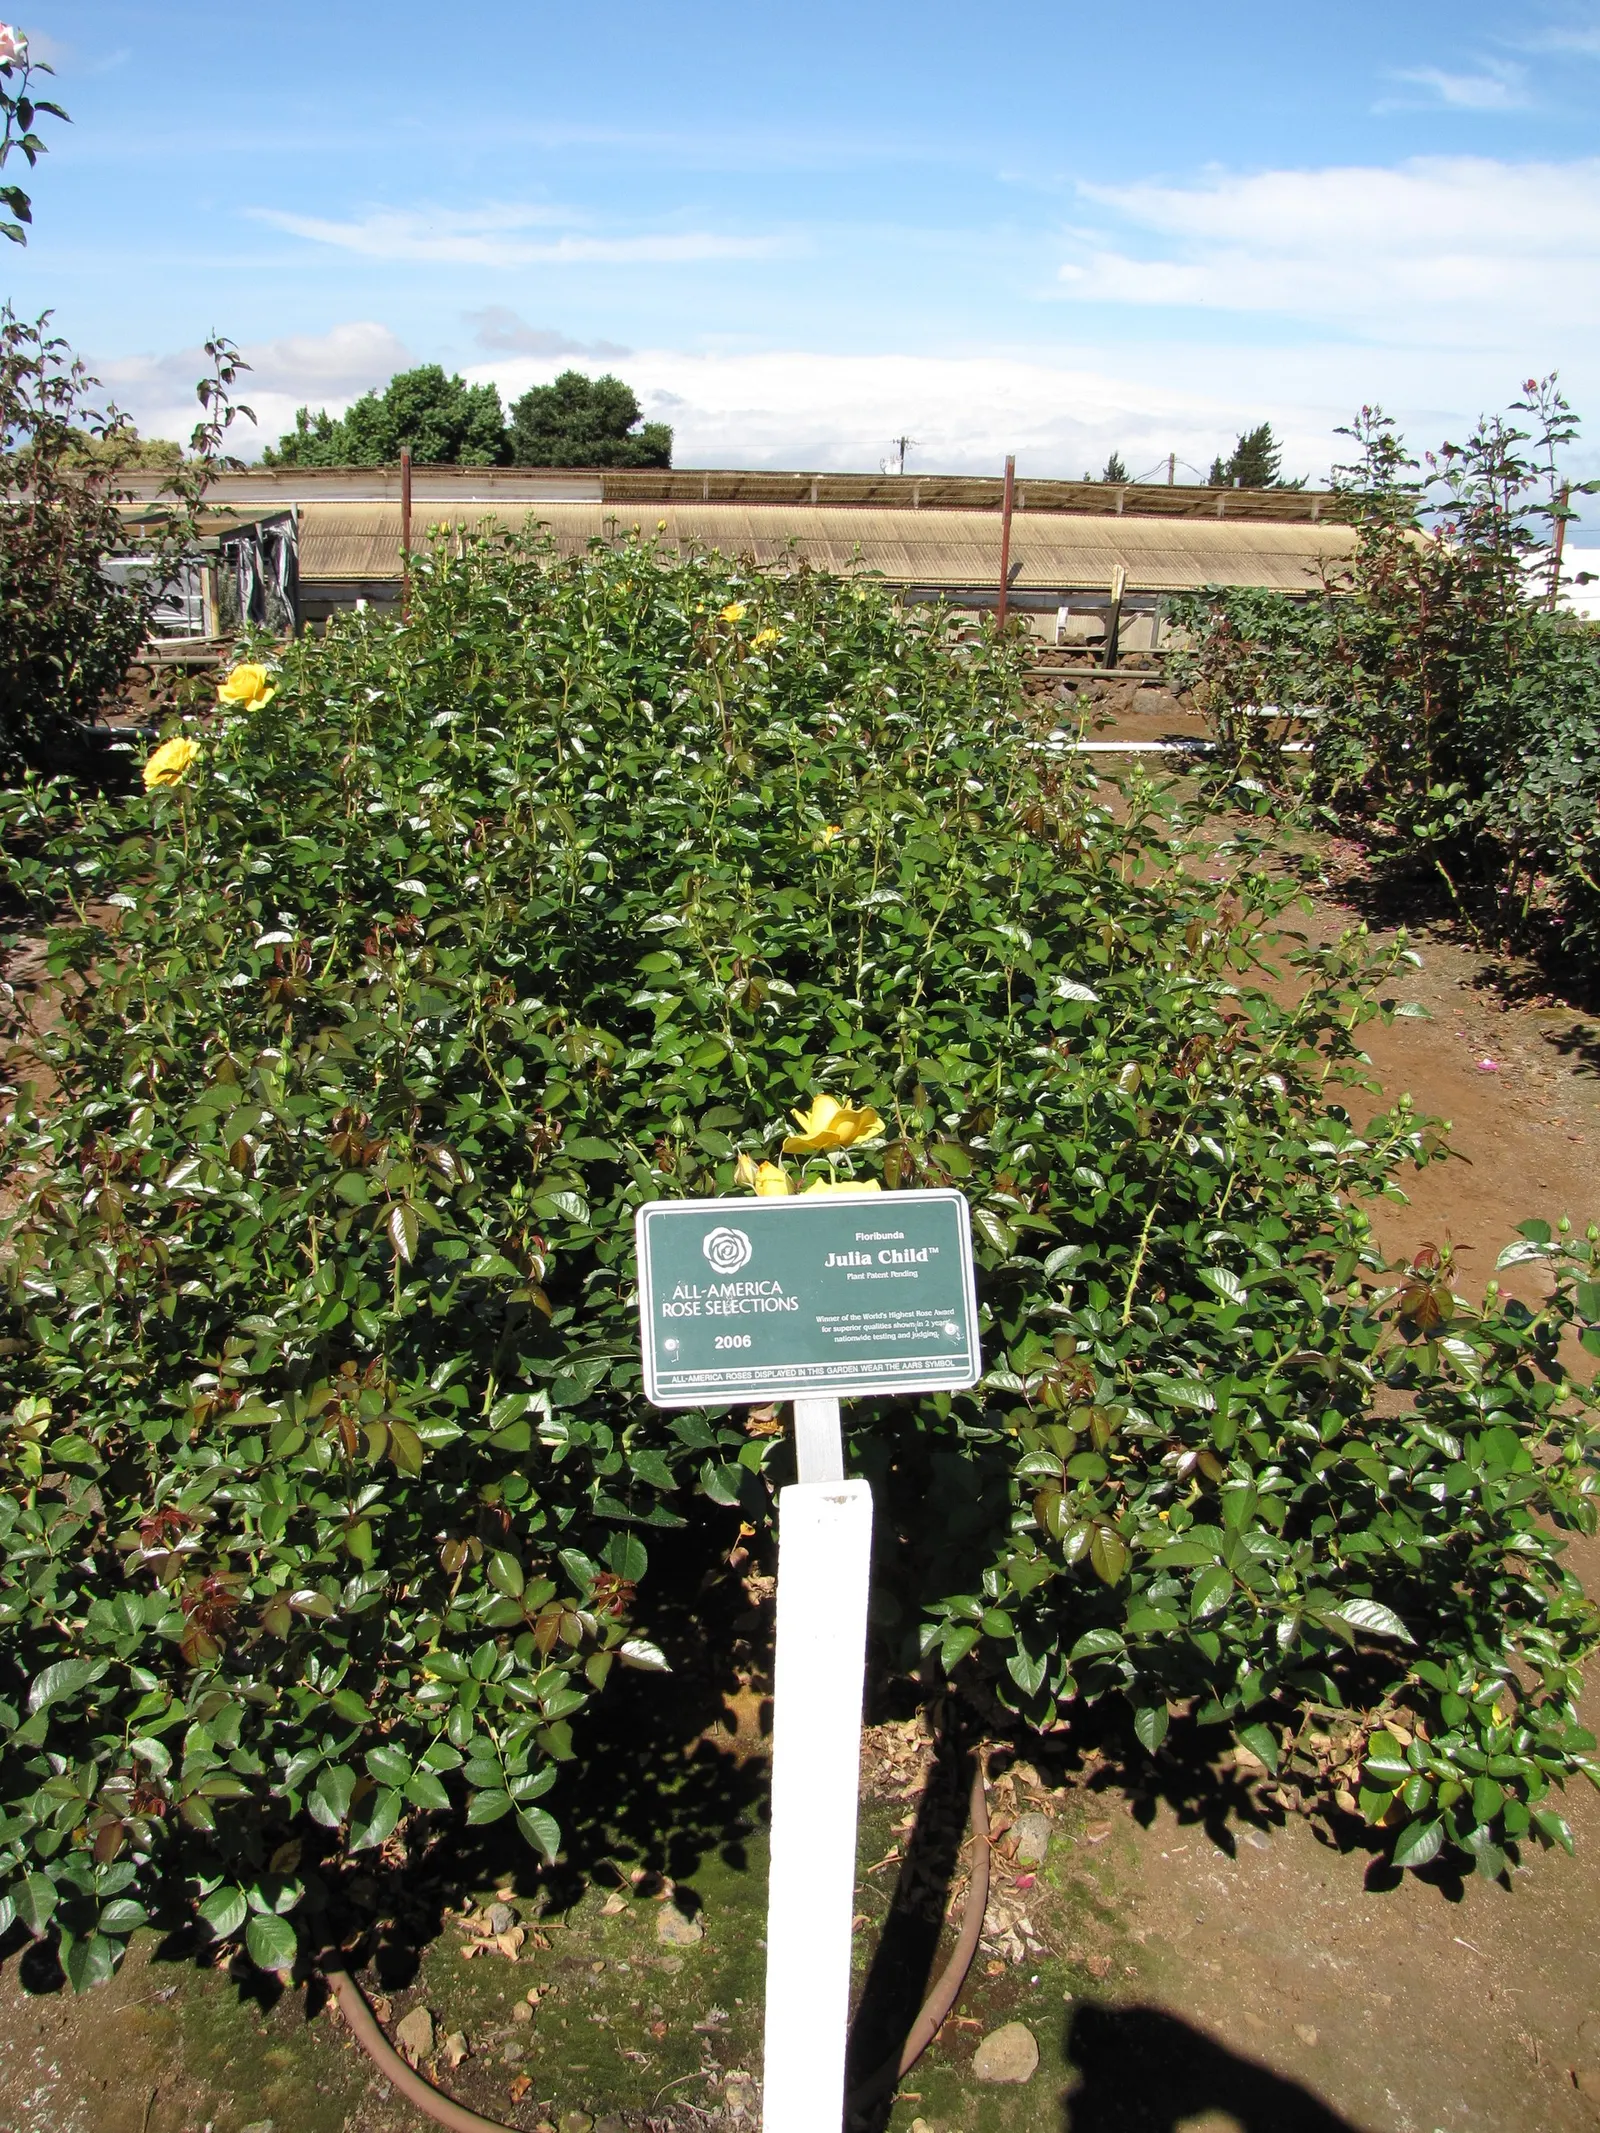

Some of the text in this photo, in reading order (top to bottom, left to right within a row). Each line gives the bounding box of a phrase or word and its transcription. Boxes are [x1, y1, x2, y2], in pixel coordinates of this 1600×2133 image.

[855, 1231, 904, 1241] Floribunda
[824, 1251, 872, 1267] Julia
[890, 1270, 918, 1278] Pending
[672, 1281, 783, 1299] ALL-AMERICA
[662, 1296, 799, 1317] ROSE SELECTIONS
[888, 1310, 914, 1320] Highest
[833, 1324, 861, 1332] superior
[863, 1322, 892, 1331] qualities
[894, 1320, 915, 1328] shown
[714, 1335, 752, 1349] 2006
[834, 1334, 872, 1342] nationwide
[873, 1332, 896, 1341] testing
[671, 1373, 723, 1383] ALL-AMERICA
[726, 1372, 752, 1380] ROSES
[754, 1369, 796, 1378] DISPLAYED
[826, 1366, 858, 1374] GARDEN
[860, 1364, 884, 1372] WEAR
[902, 1361, 922, 1370] AARS
[924, 1360, 955, 1368] SYMBOL
